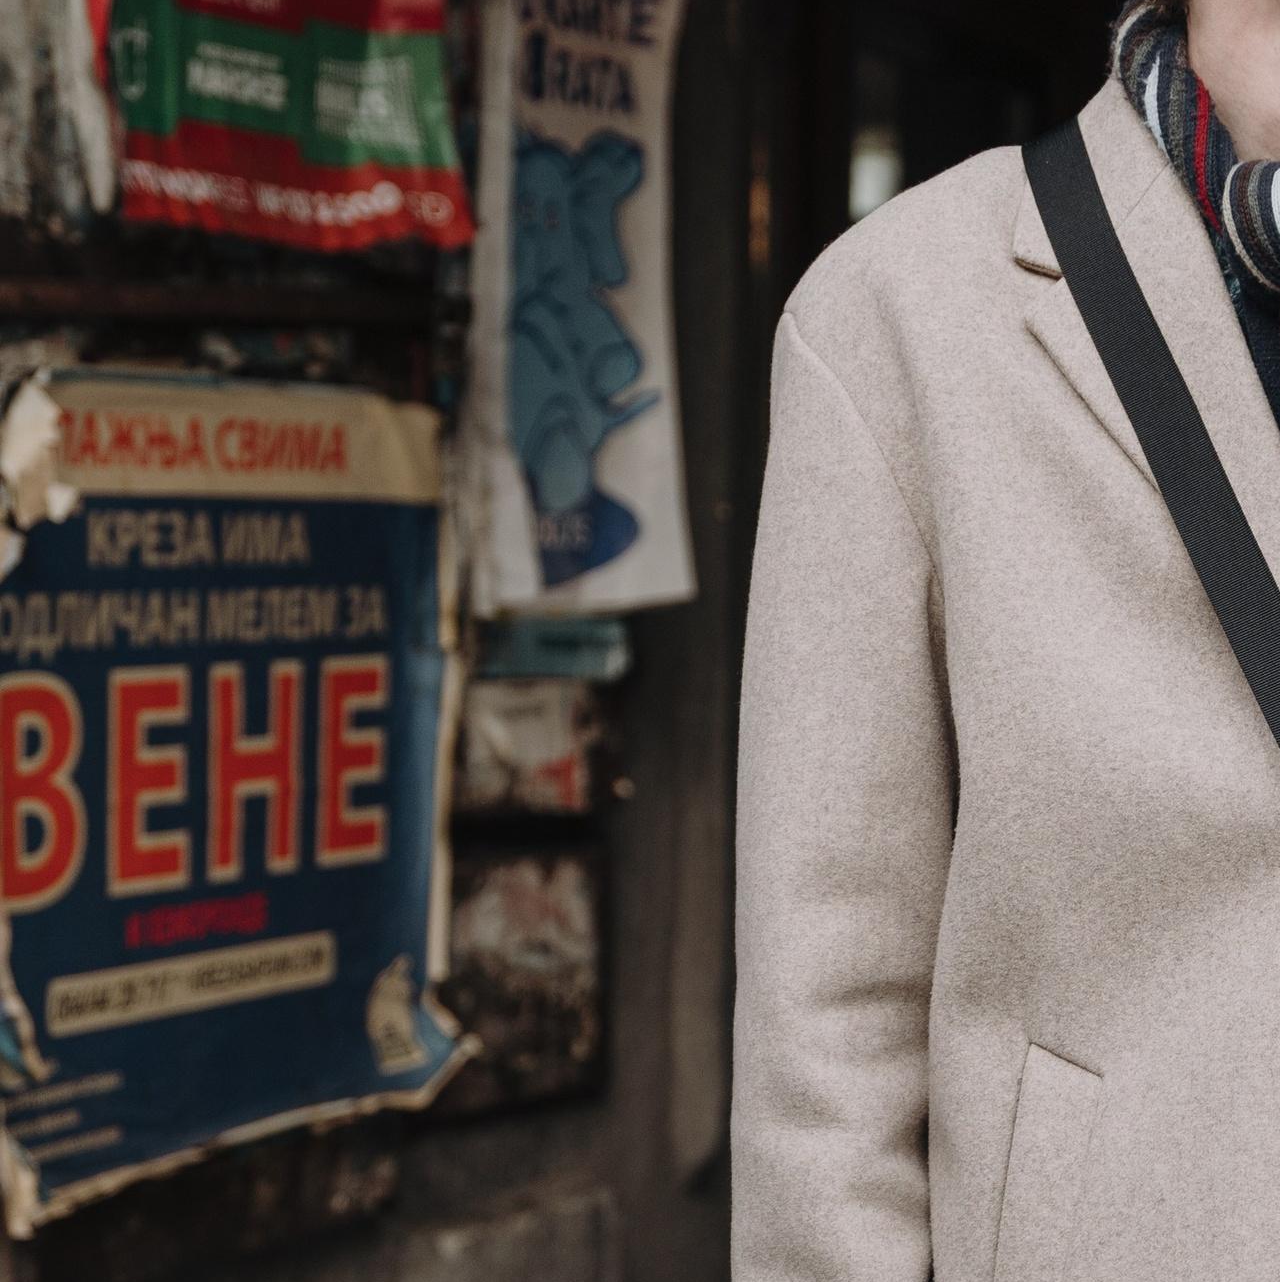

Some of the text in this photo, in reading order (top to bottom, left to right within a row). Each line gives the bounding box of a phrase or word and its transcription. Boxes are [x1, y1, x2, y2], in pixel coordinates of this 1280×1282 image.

[213, 417, 347, 473] СВИМА
[86, 509, 312, 570] КРЕЗА ИМА
[0, 584, 391, 664] ОДЛИЧАН МЕЛЕМ ЗА
[0, 651, 393, 917] ВЕНЕ
